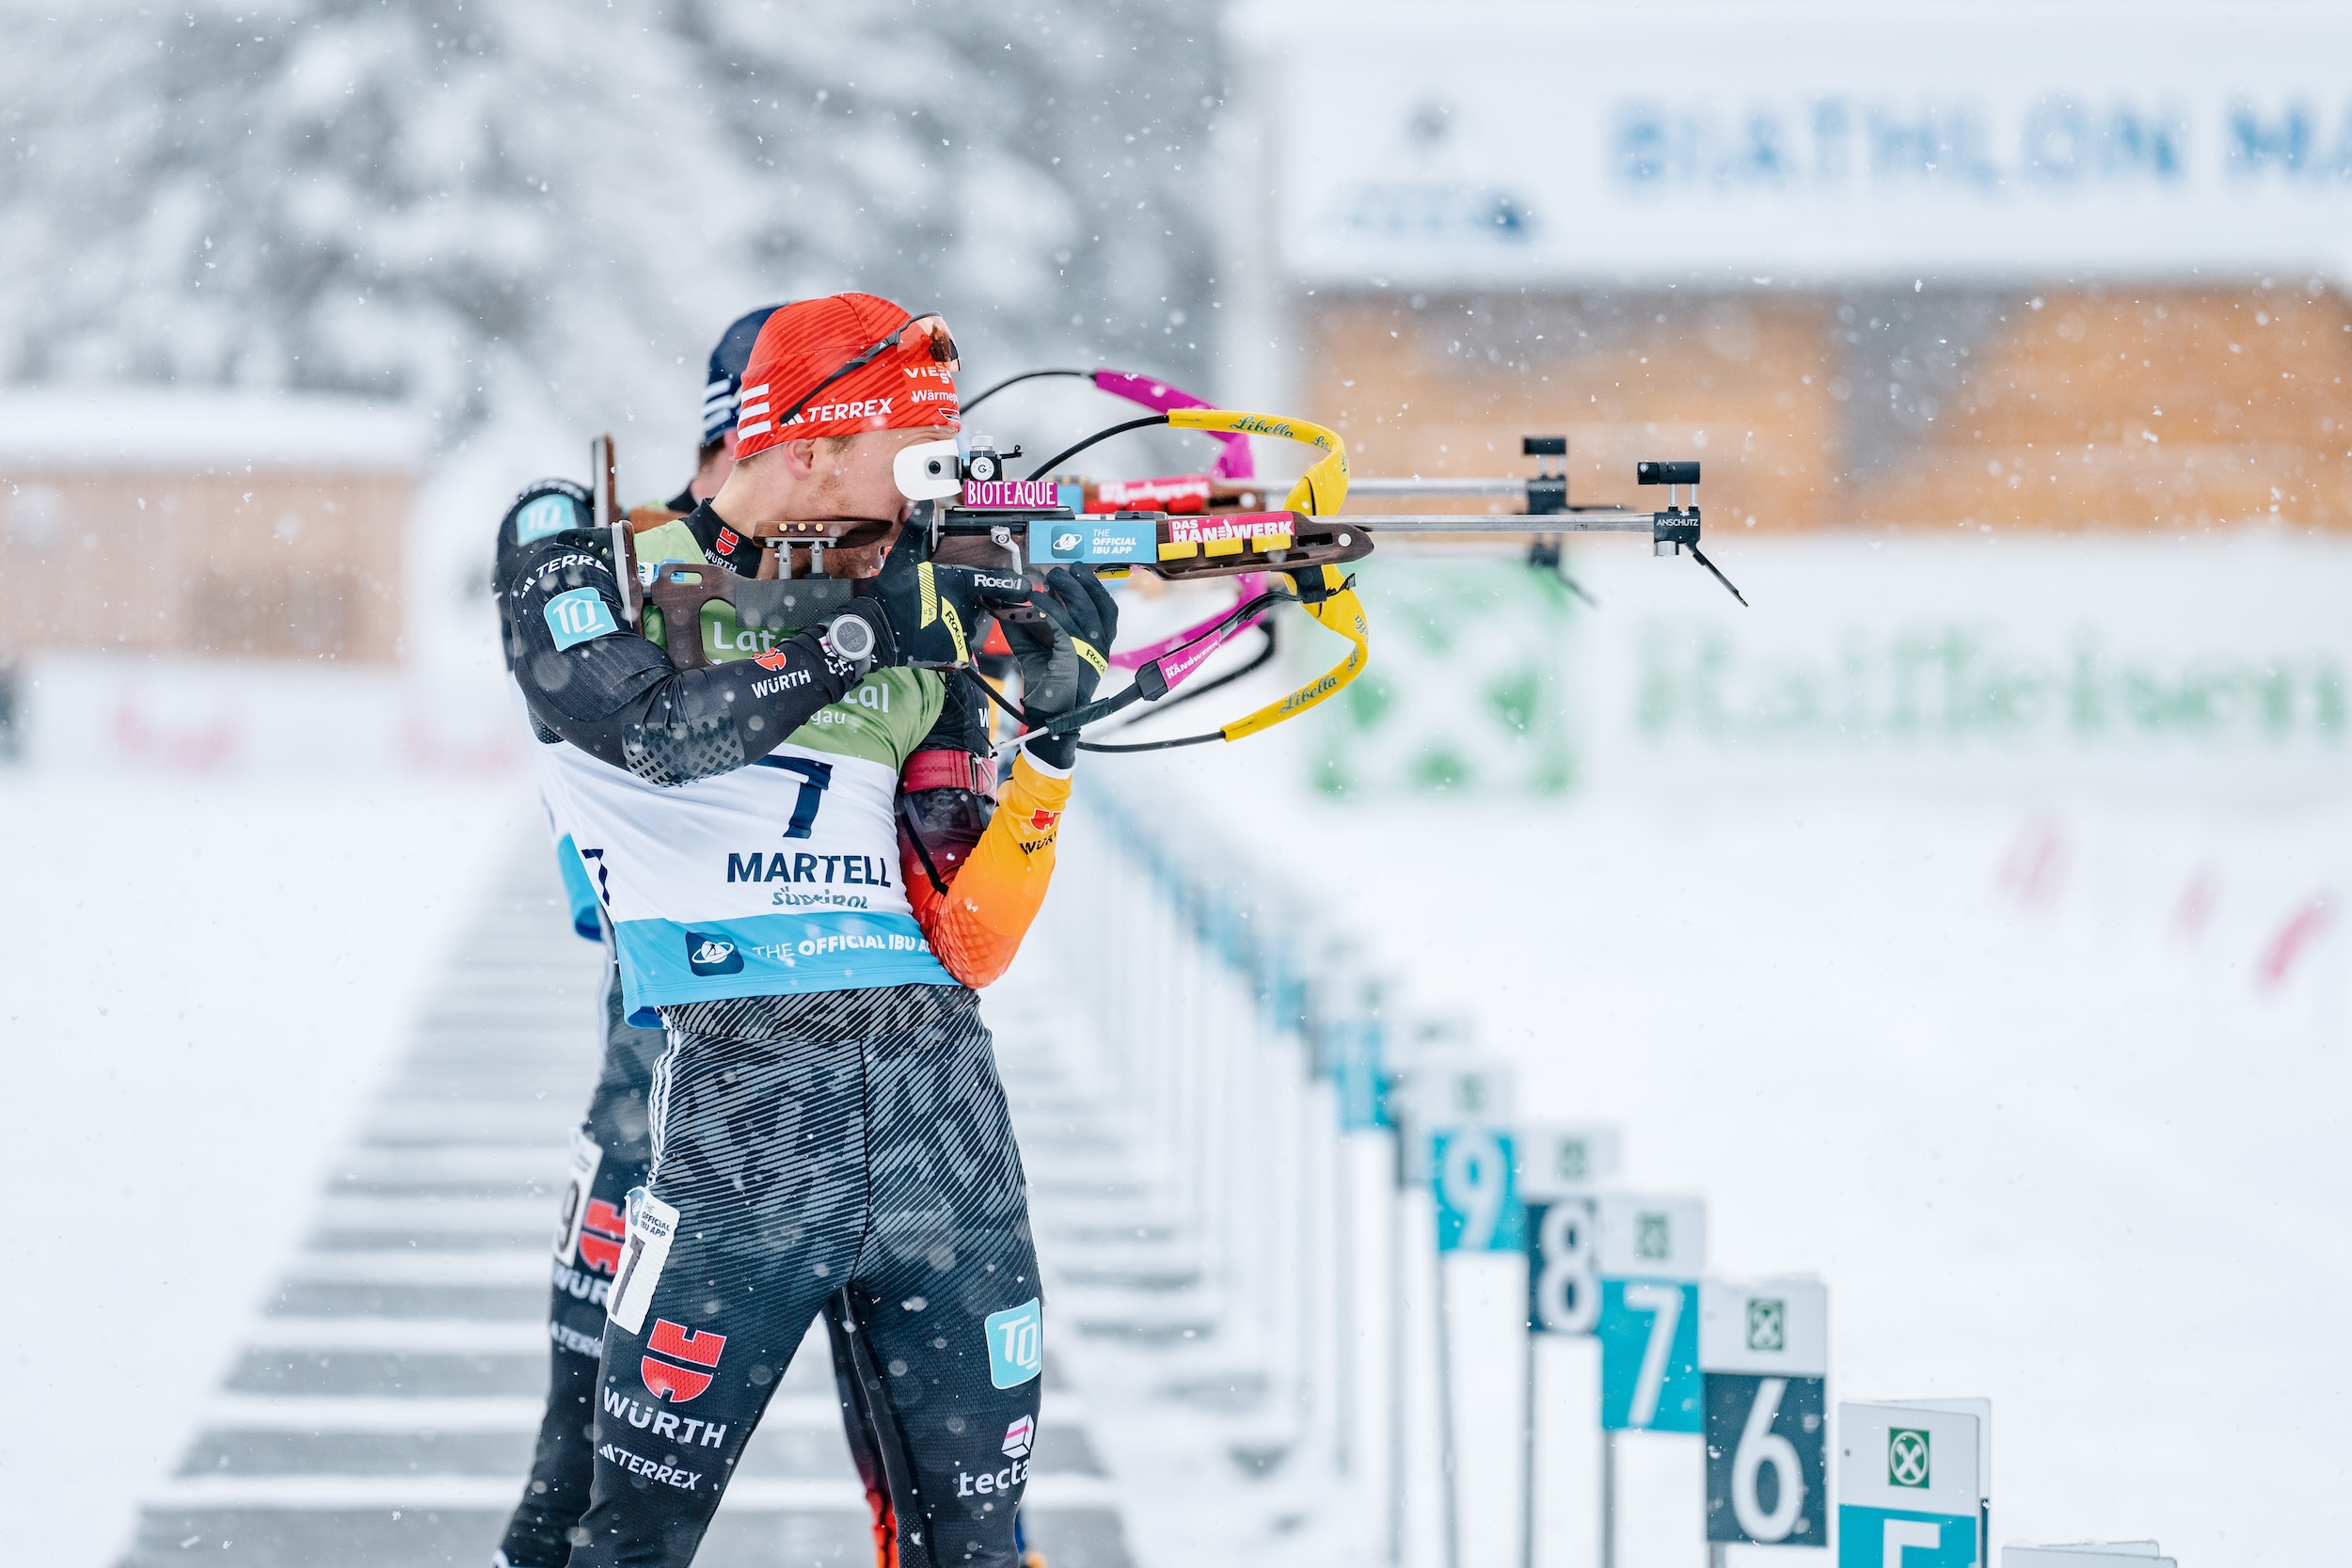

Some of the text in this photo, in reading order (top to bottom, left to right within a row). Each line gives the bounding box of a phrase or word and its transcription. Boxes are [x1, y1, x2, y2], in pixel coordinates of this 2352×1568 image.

[807, 397, 894, 423] TERREX
[1229, 415, 1295, 439] Libella
[967, 481, 1057, 507] BIOTEAQUE
[1092, 529, 1111, 537] THE
[1171, 519, 1199, 531] DAS
[1092, 538, 1136, 546] OFFICIAL
[1092, 546, 1133, 555] IBU APP
[751, 669, 812, 700] WÜRTH
[1279, 674, 1338, 714] Libella
[753, 753, 834, 840] 7
[726, 852, 892, 888] MARTELL
[753, 942, 795, 959] THE
[798, 935, 886, 957] OFFICIAL
[888, 934, 916, 951] IBU
[1441, 1128, 1505, 1252] 9
[642, 1211, 670, 1232] OFFICIAL
[649, 1227, 666, 1238] APP
[1537, 1198, 1600, 1335] 8
[998, 1314, 1039, 1370] TQ
[1623, 1282, 1683, 1427] 7
[603, 1386, 727, 1449] WÜRTH
[617, 1448, 703, 1491] TERREX
[1732, 1377, 1805, 1543] 6
